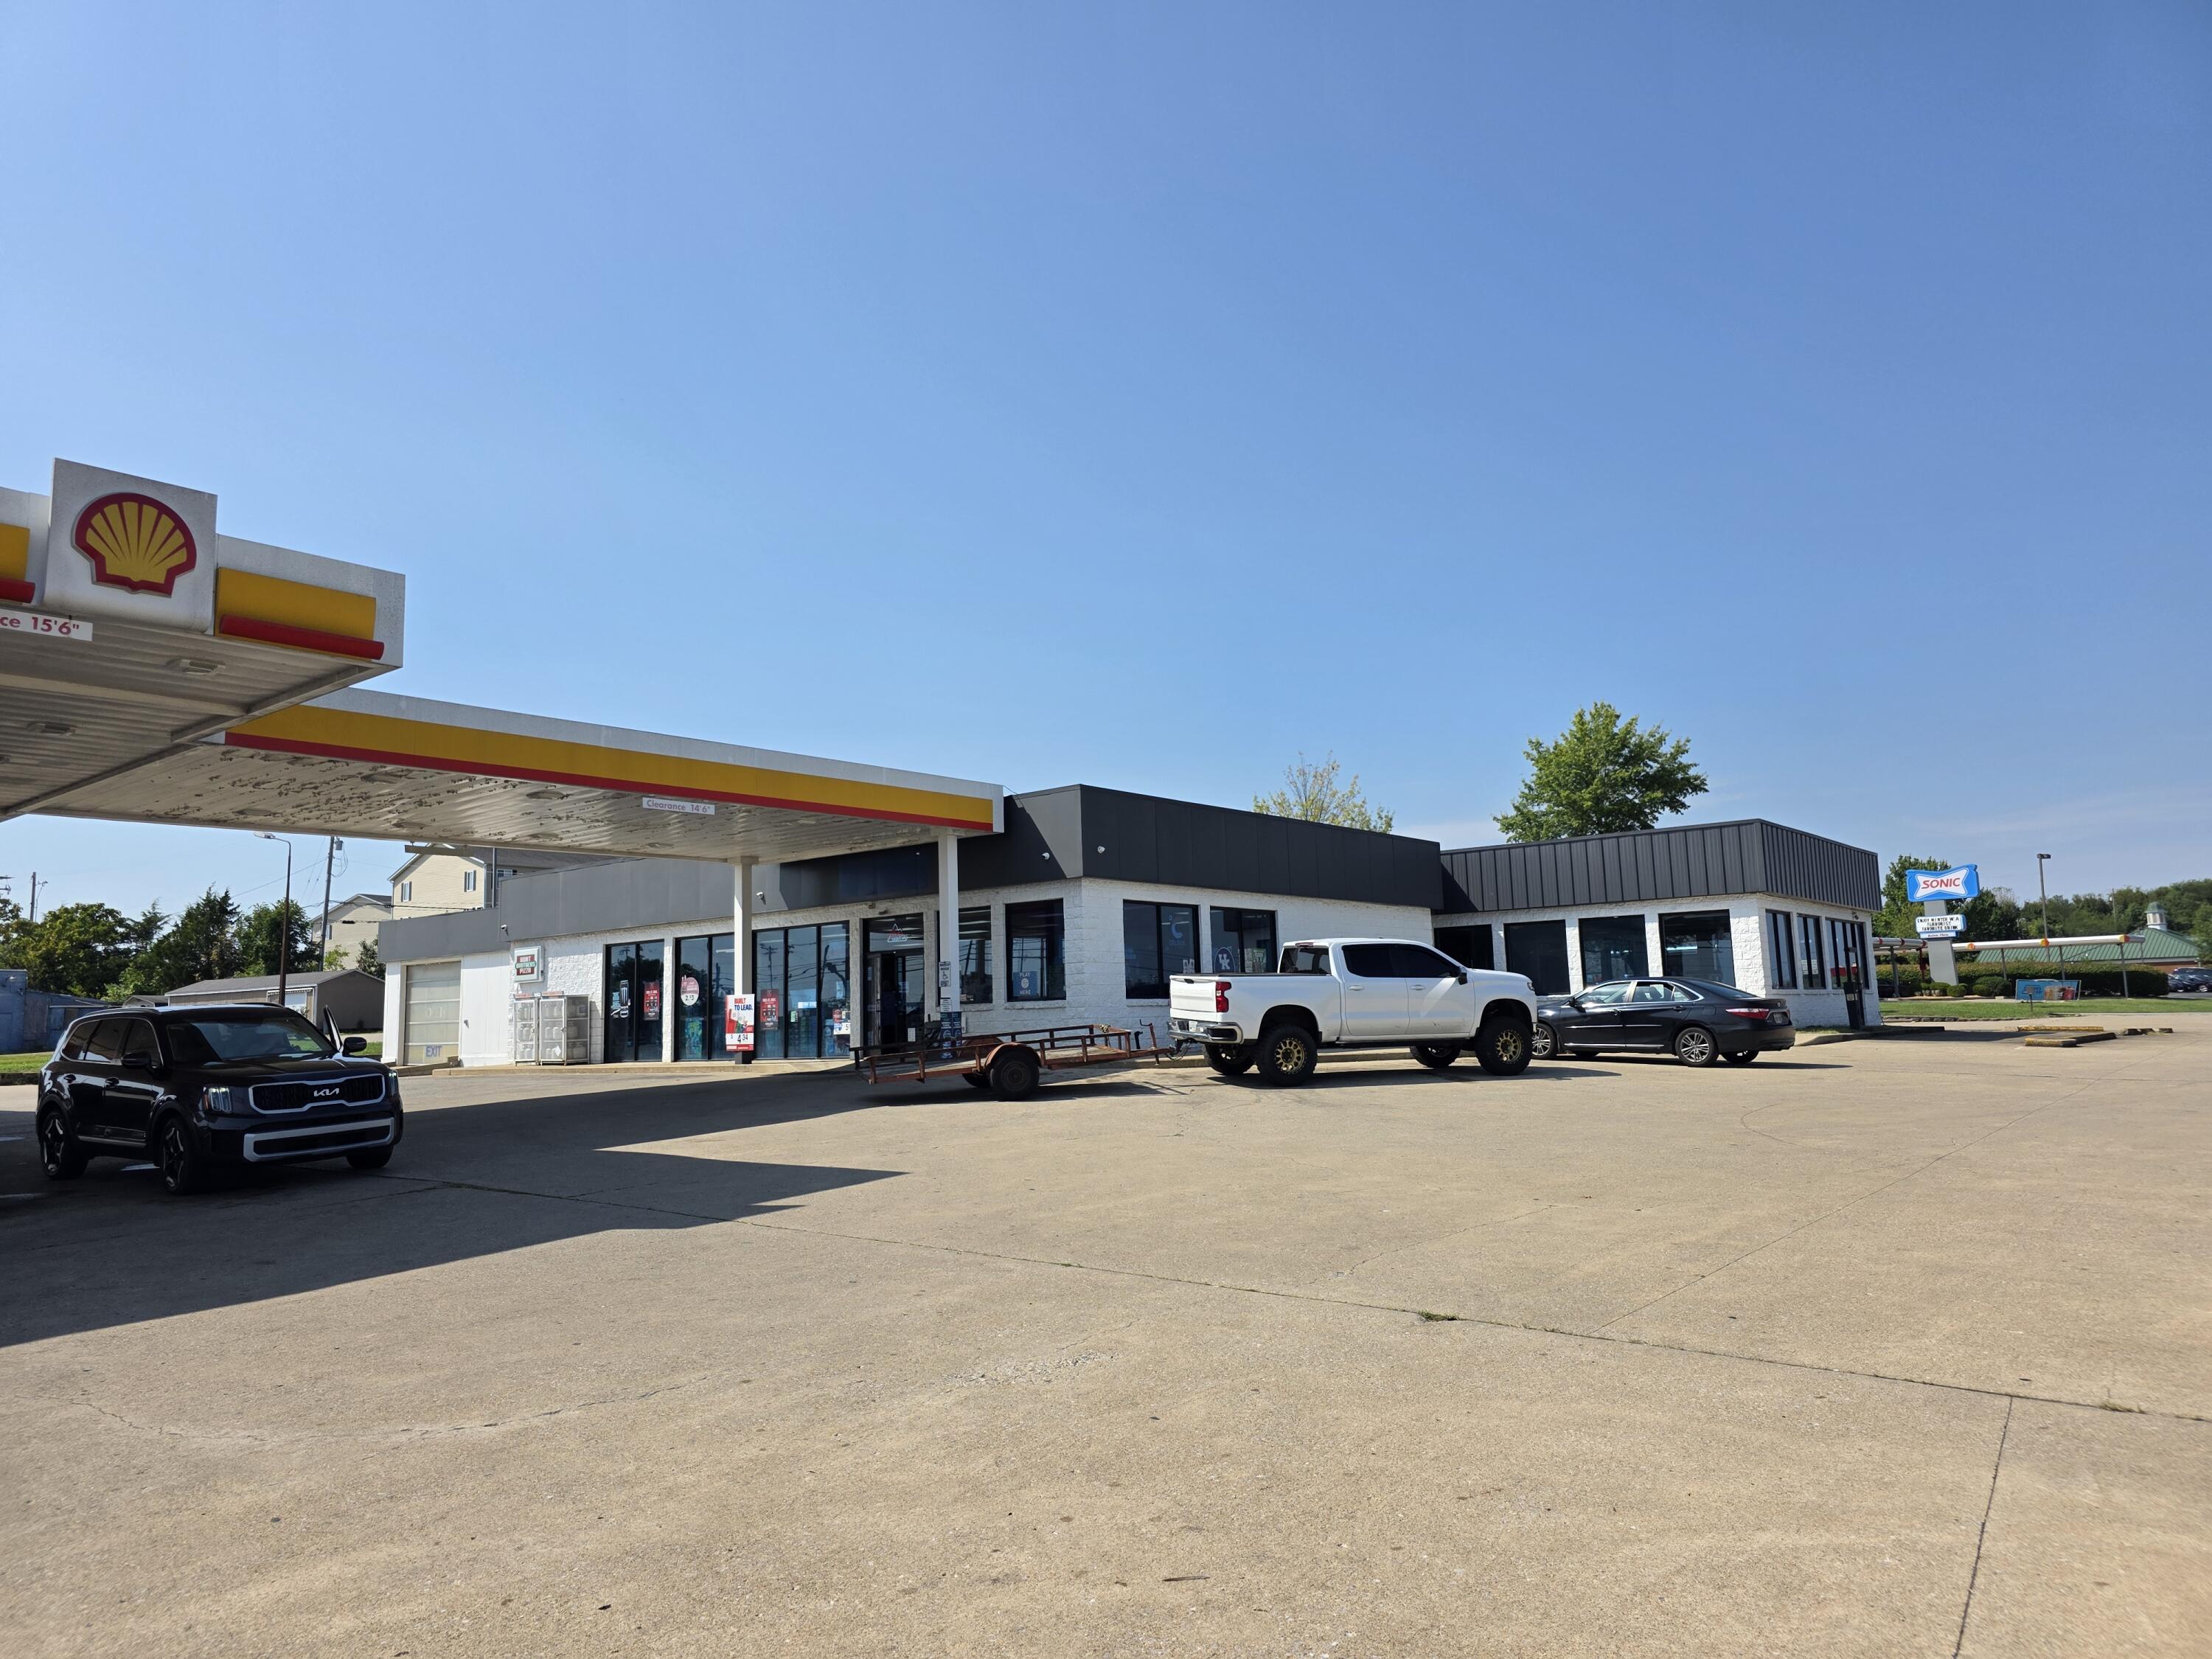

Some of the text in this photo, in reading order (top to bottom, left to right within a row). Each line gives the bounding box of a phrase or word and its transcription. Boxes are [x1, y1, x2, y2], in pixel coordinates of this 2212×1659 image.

[32, 616, 80, 636] 15'6"
[647, 799, 686, 811] Clearance
[1921, 877, 1961, 889] SONIC
[1218, 953, 1231, 970] UK
[425, 1046, 442, 1057] EXIT
